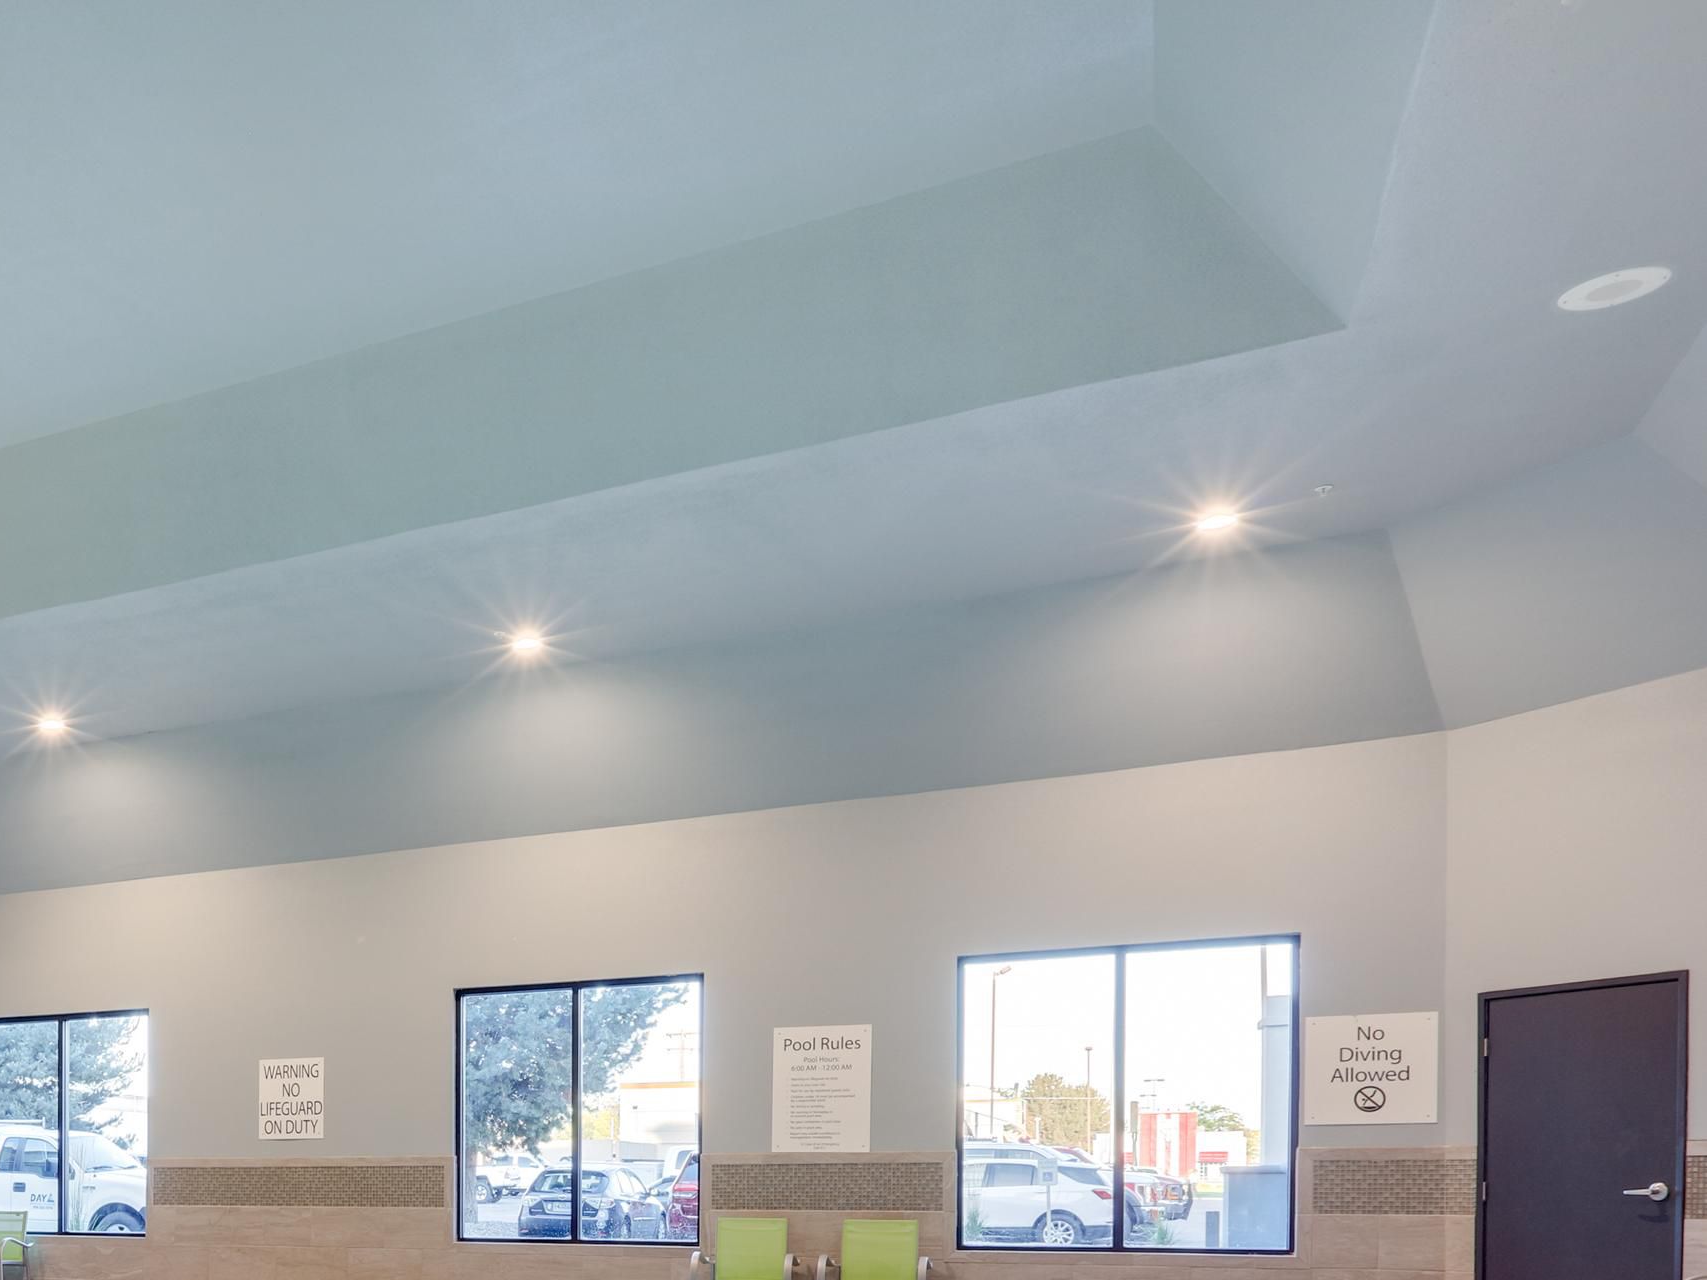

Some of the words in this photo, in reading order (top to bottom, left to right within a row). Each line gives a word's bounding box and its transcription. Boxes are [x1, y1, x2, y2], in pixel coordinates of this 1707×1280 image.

[1357, 1026, 1385, 1041] No
[783, 1037, 816, 1051] Pool
[821, 1036, 861, 1050] Rules
[1339, 1046, 1402, 1065] Diving
[263, 1063, 319, 1079] WARNING
[1330, 1065, 1410, 1083] Allowed
[282, 1082, 301, 1098] NO
[260, 1100, 323, 1117] LIFEGUARD
[264, 1120, 282, 1135] ON
[285, 1119, 319, 1134] DUTY
